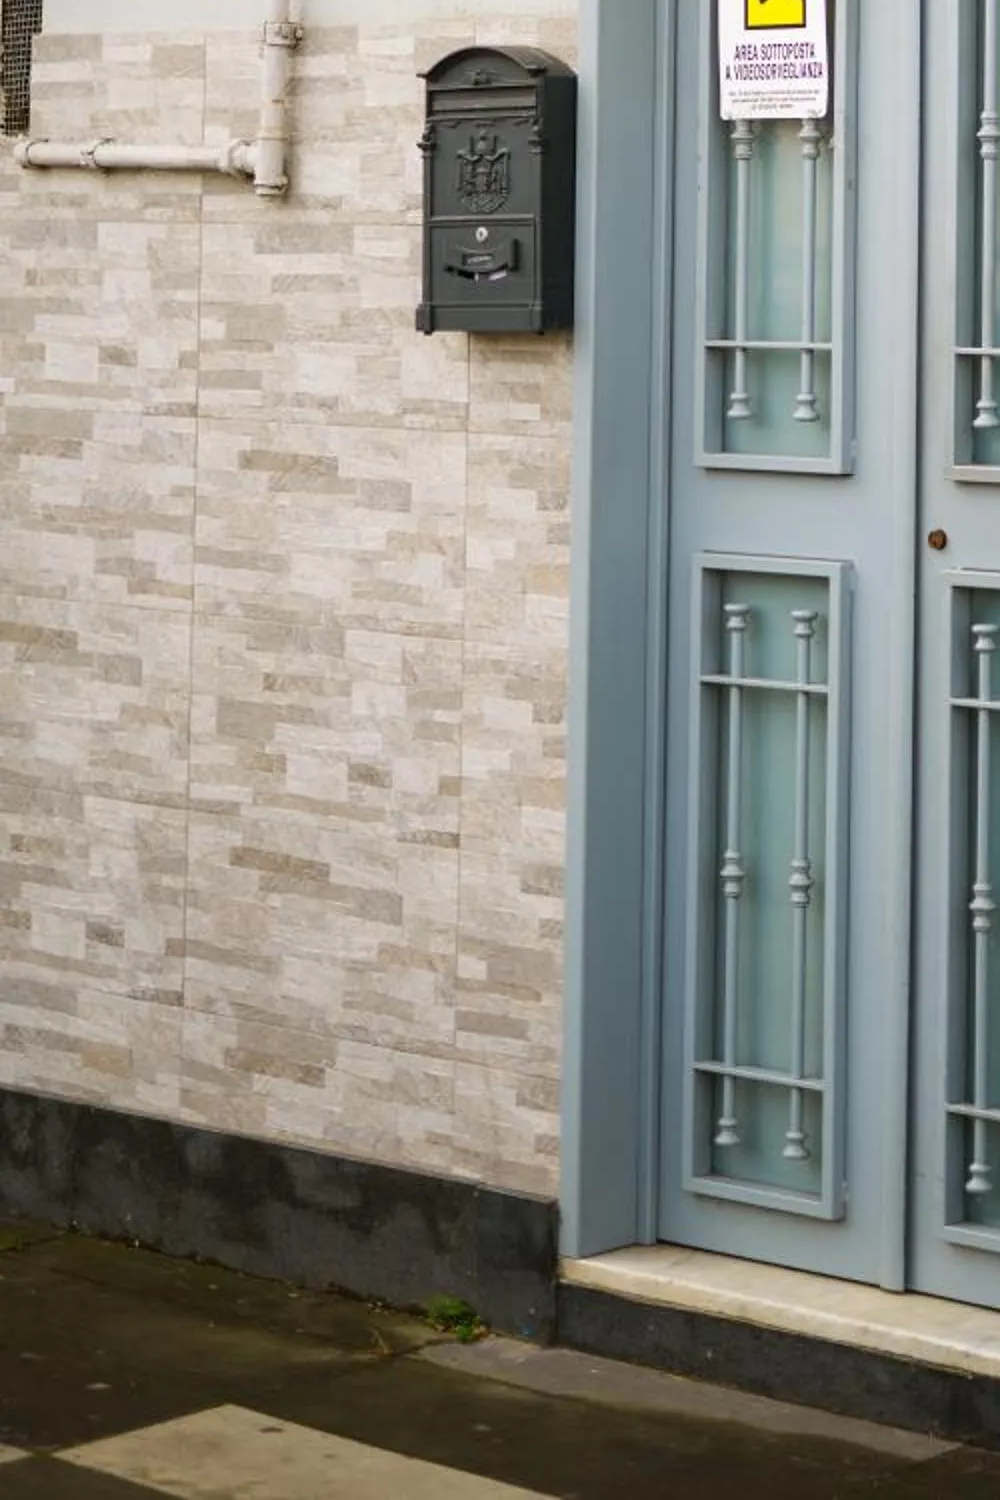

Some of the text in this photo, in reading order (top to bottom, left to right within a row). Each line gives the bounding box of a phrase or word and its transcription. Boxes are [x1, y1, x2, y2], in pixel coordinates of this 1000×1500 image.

[734, 41, 816, 61] AREA SOTTOPOSTA
[725, 64, 732, 80] A
